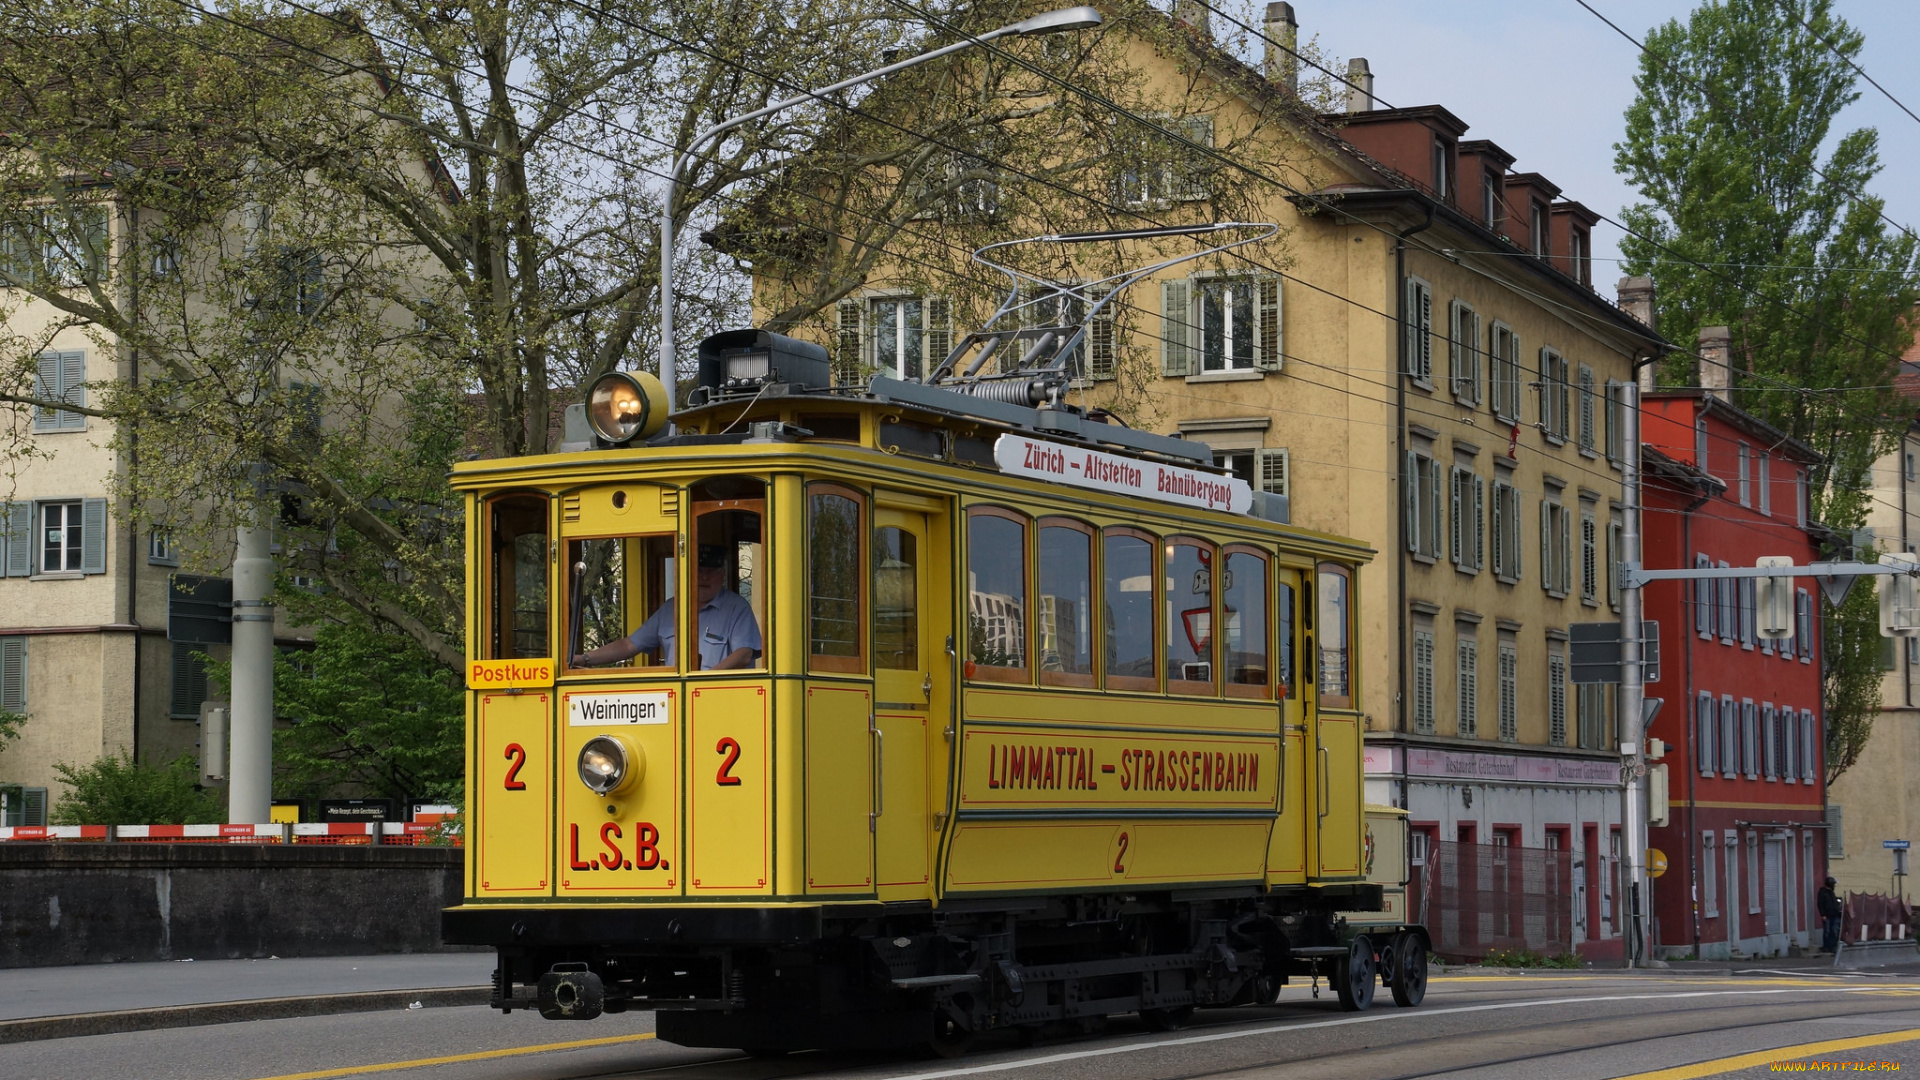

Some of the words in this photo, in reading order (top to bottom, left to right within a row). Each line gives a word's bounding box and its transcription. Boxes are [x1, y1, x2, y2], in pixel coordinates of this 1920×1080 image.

[1024, 442, 1064, 474] Zürich
[1084, 453, 1141, 488] Altstetten
[1158, 468, 1232, 511] Bahnübergang
[472, 662, 549, 682] Postkurs
[580, 699, 656, 722] Weiningen
[504, 742, 526, 791] 2
[716, 737, 741, 786] 2
[1446, 756, 1477, 774] Restaurant
[570, 822, 669, 871] L.S.B.
[1114, 831, 1129, 873] 2
